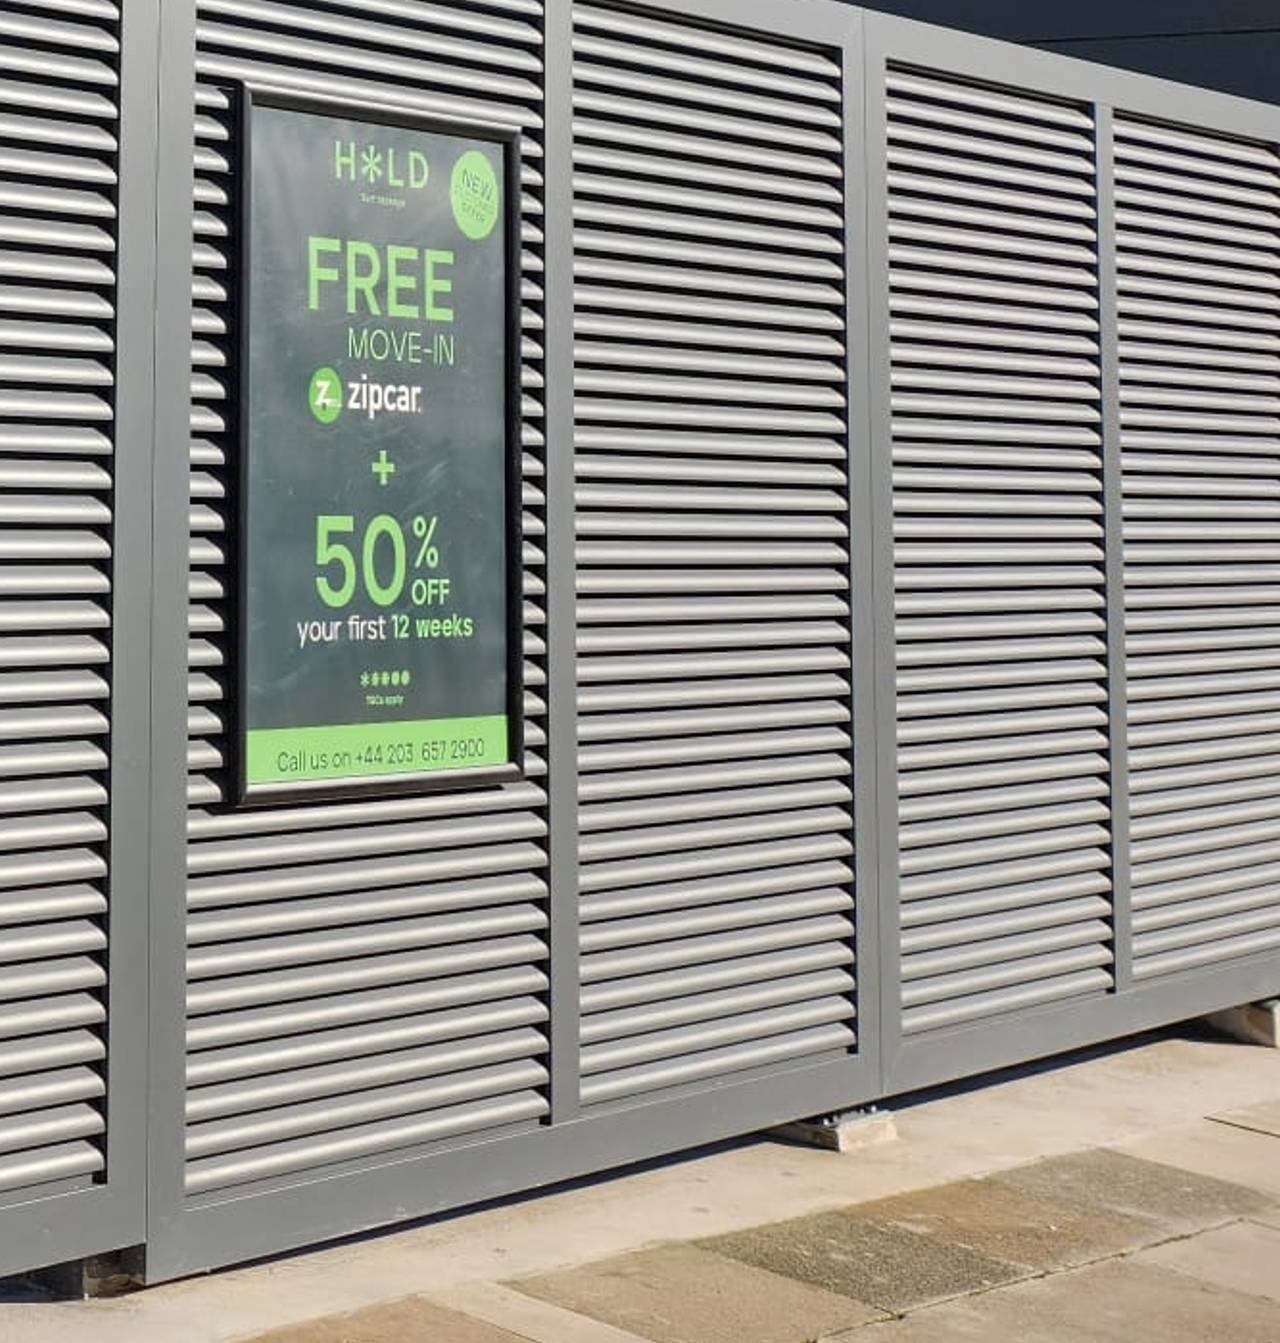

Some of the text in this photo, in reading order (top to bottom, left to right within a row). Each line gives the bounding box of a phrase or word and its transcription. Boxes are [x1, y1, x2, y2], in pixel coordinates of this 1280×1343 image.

[306, 235, 454, 323] FREE
[347, 327, 455, 366] MOVE-IN
[411, 578, 451, 605] OFF
[297, 612, 474, 649] your first 12 weeks
[277, 750, 307, 773] Call
[310, 753, 329, 770] us
[331, 751, 352, 769] on
[355, 744, 384, 765] +44
[387, 742, 414, 765] 203
